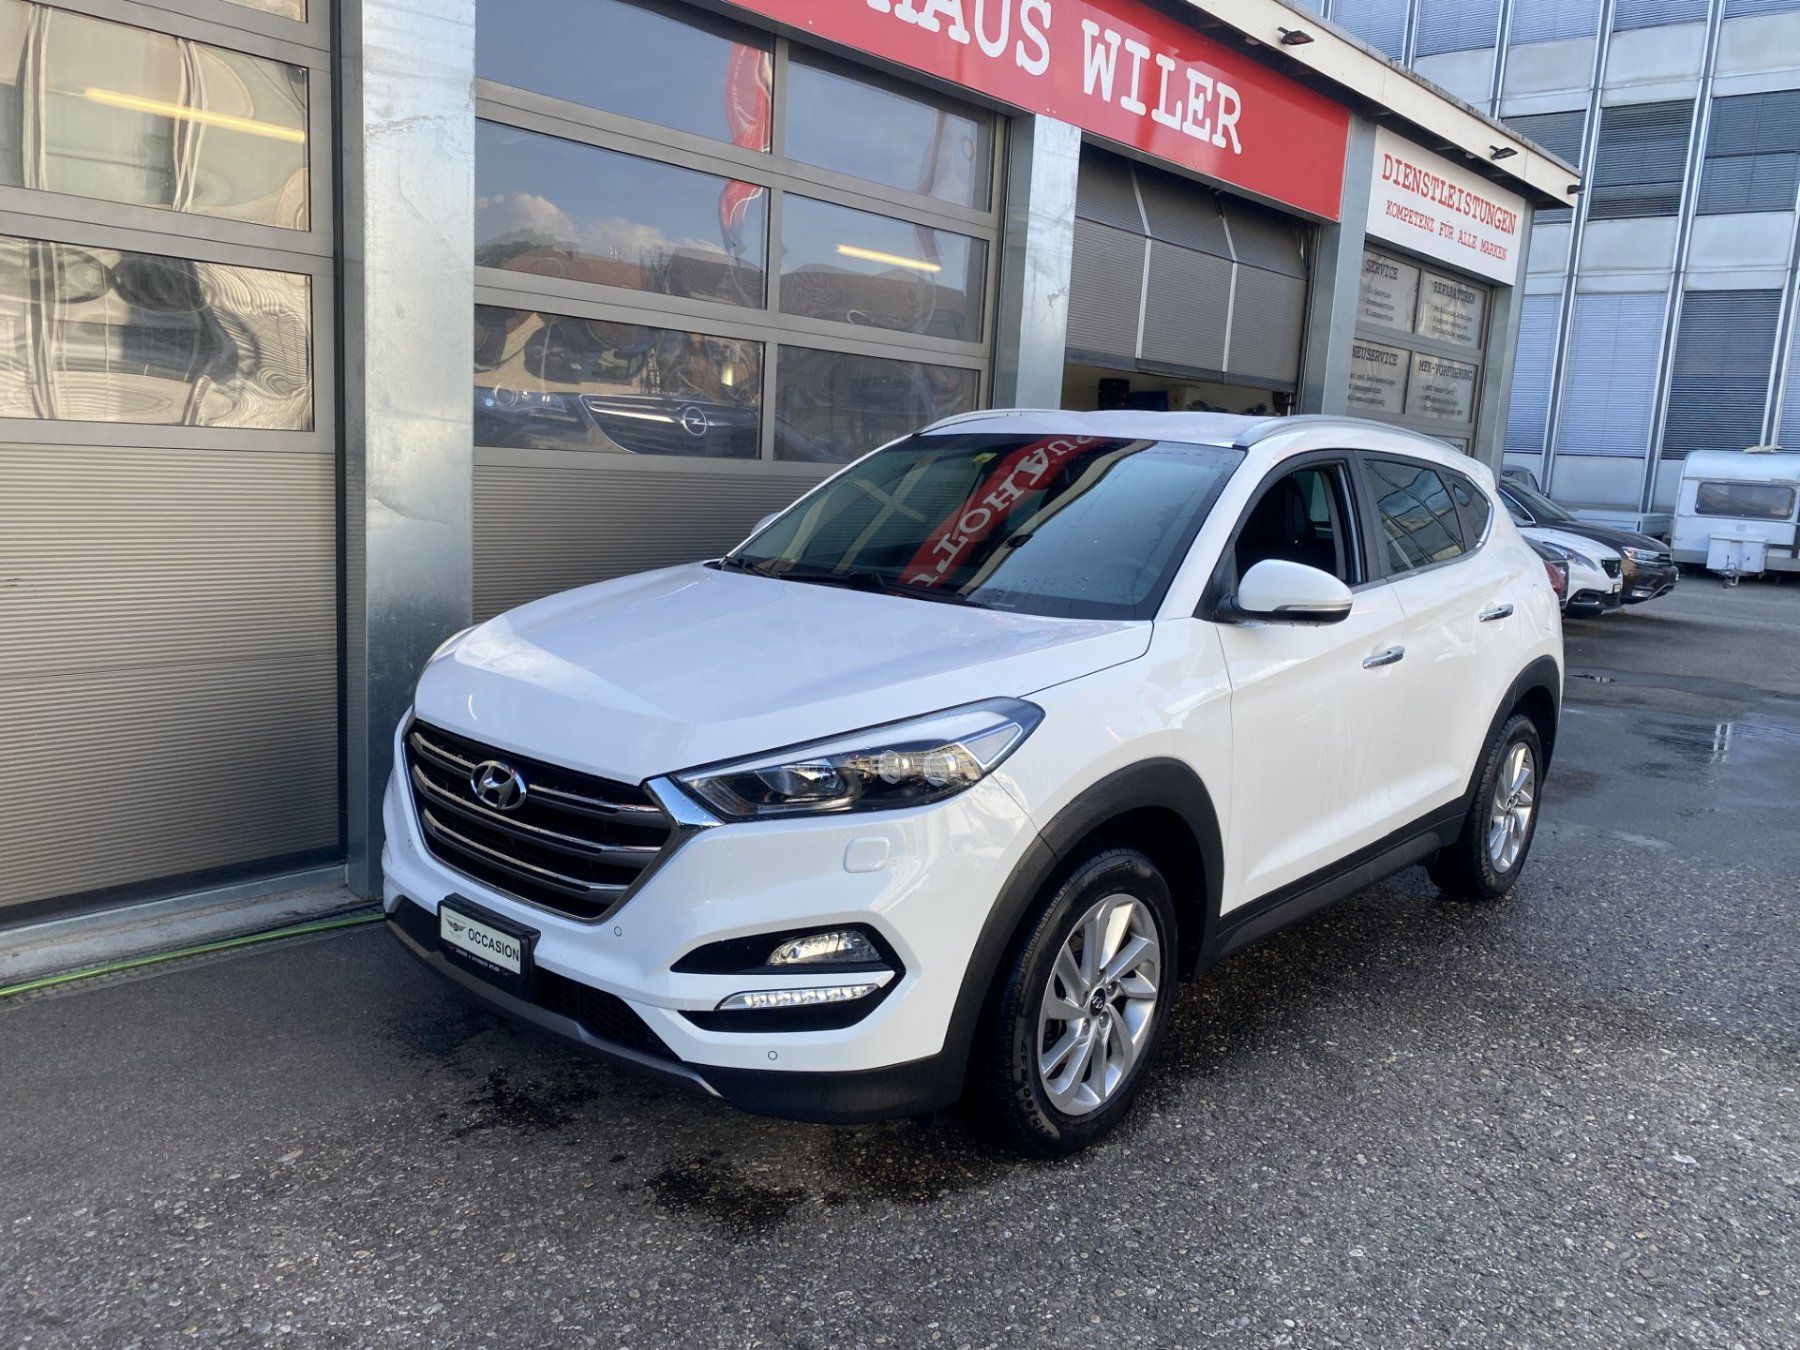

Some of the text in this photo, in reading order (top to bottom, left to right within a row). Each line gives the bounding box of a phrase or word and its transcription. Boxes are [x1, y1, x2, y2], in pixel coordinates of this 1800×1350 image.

[867, 0, 1243, 155] AUS WILER
[1382, 153, 1517, 236] DIENSTLEISTUNGEN
[1386, 200, 1435, 233] KOMPETENZ
[1457, 229, 1478, 249] ALLE
[1480, 238, 1507, 261] MARKEN
[1366, 259, 1399, 280] SERVICE
[468, 928, 520, 962] OCCASION
